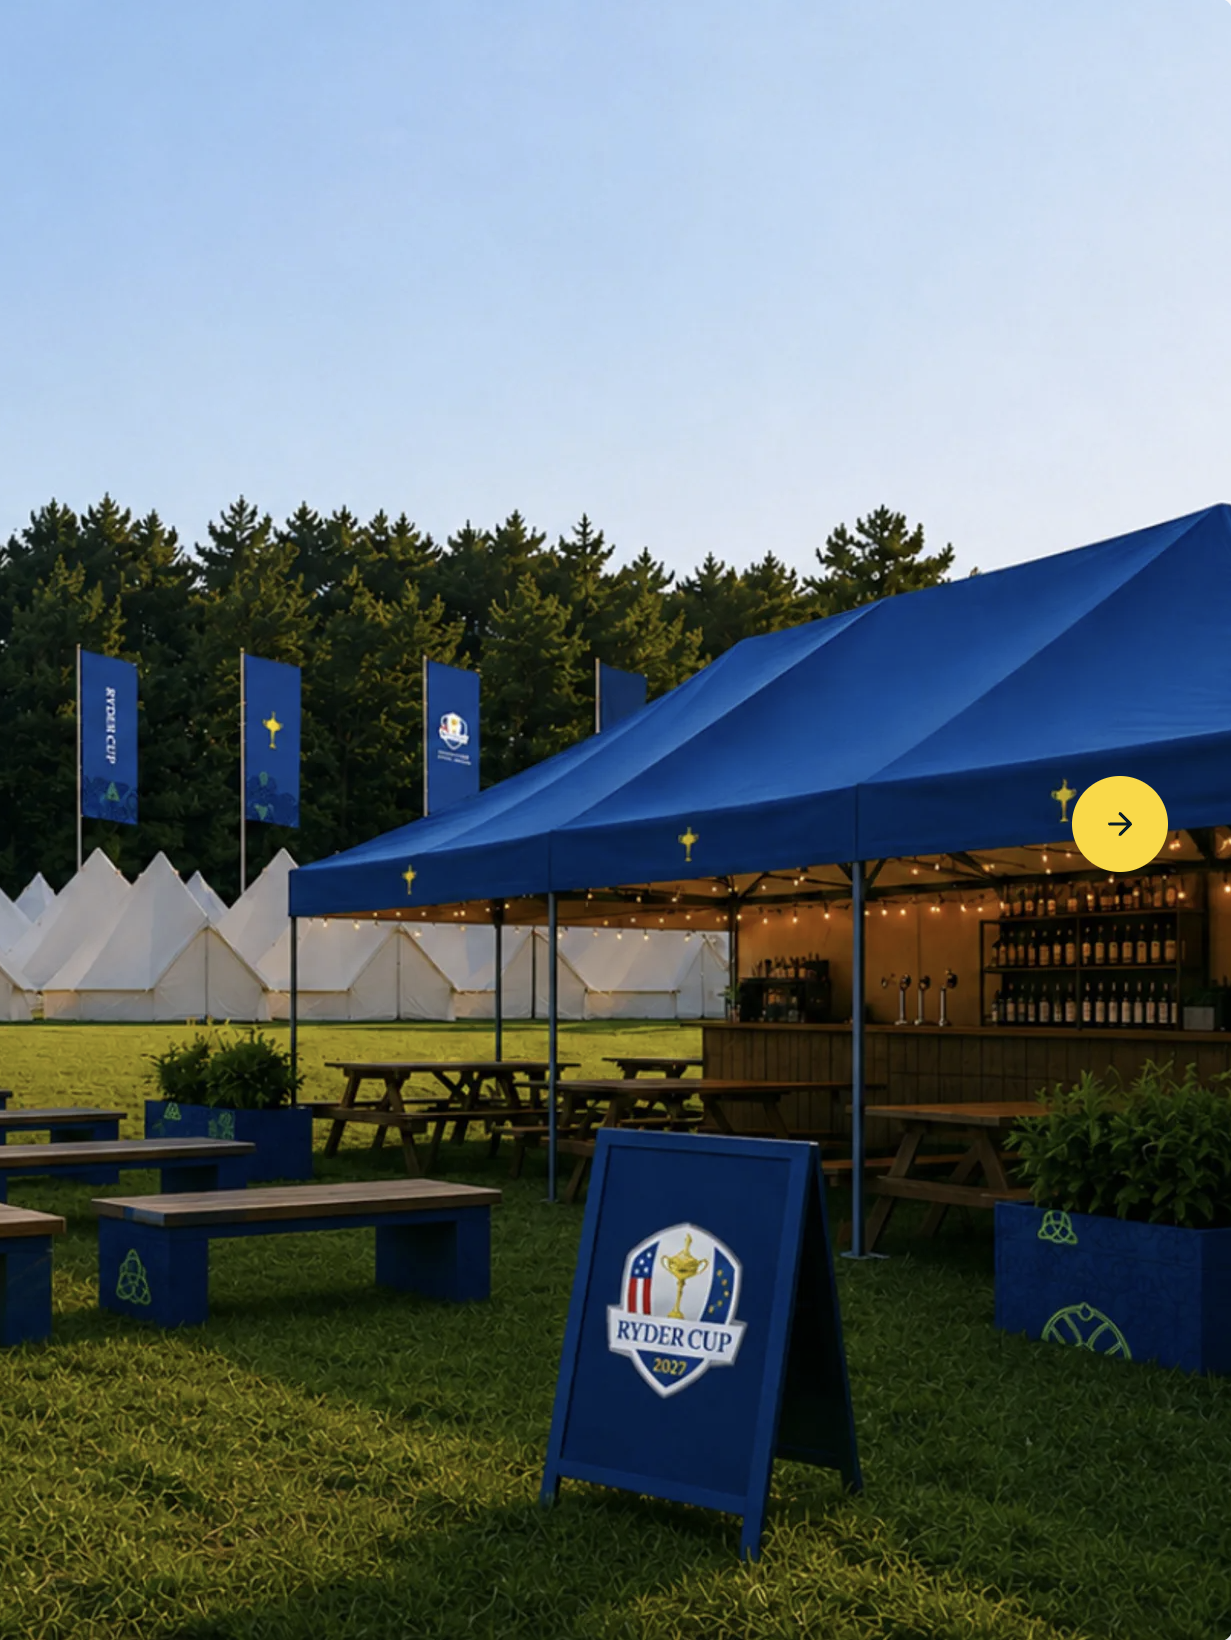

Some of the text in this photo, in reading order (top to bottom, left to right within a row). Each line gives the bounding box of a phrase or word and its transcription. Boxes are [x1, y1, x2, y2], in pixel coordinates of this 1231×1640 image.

[105, 686, 116, 764] RYDER CUP
[616, 1320, 733, 1353] RYDER CUP
[653, 1357, 687, 1376] 2027
